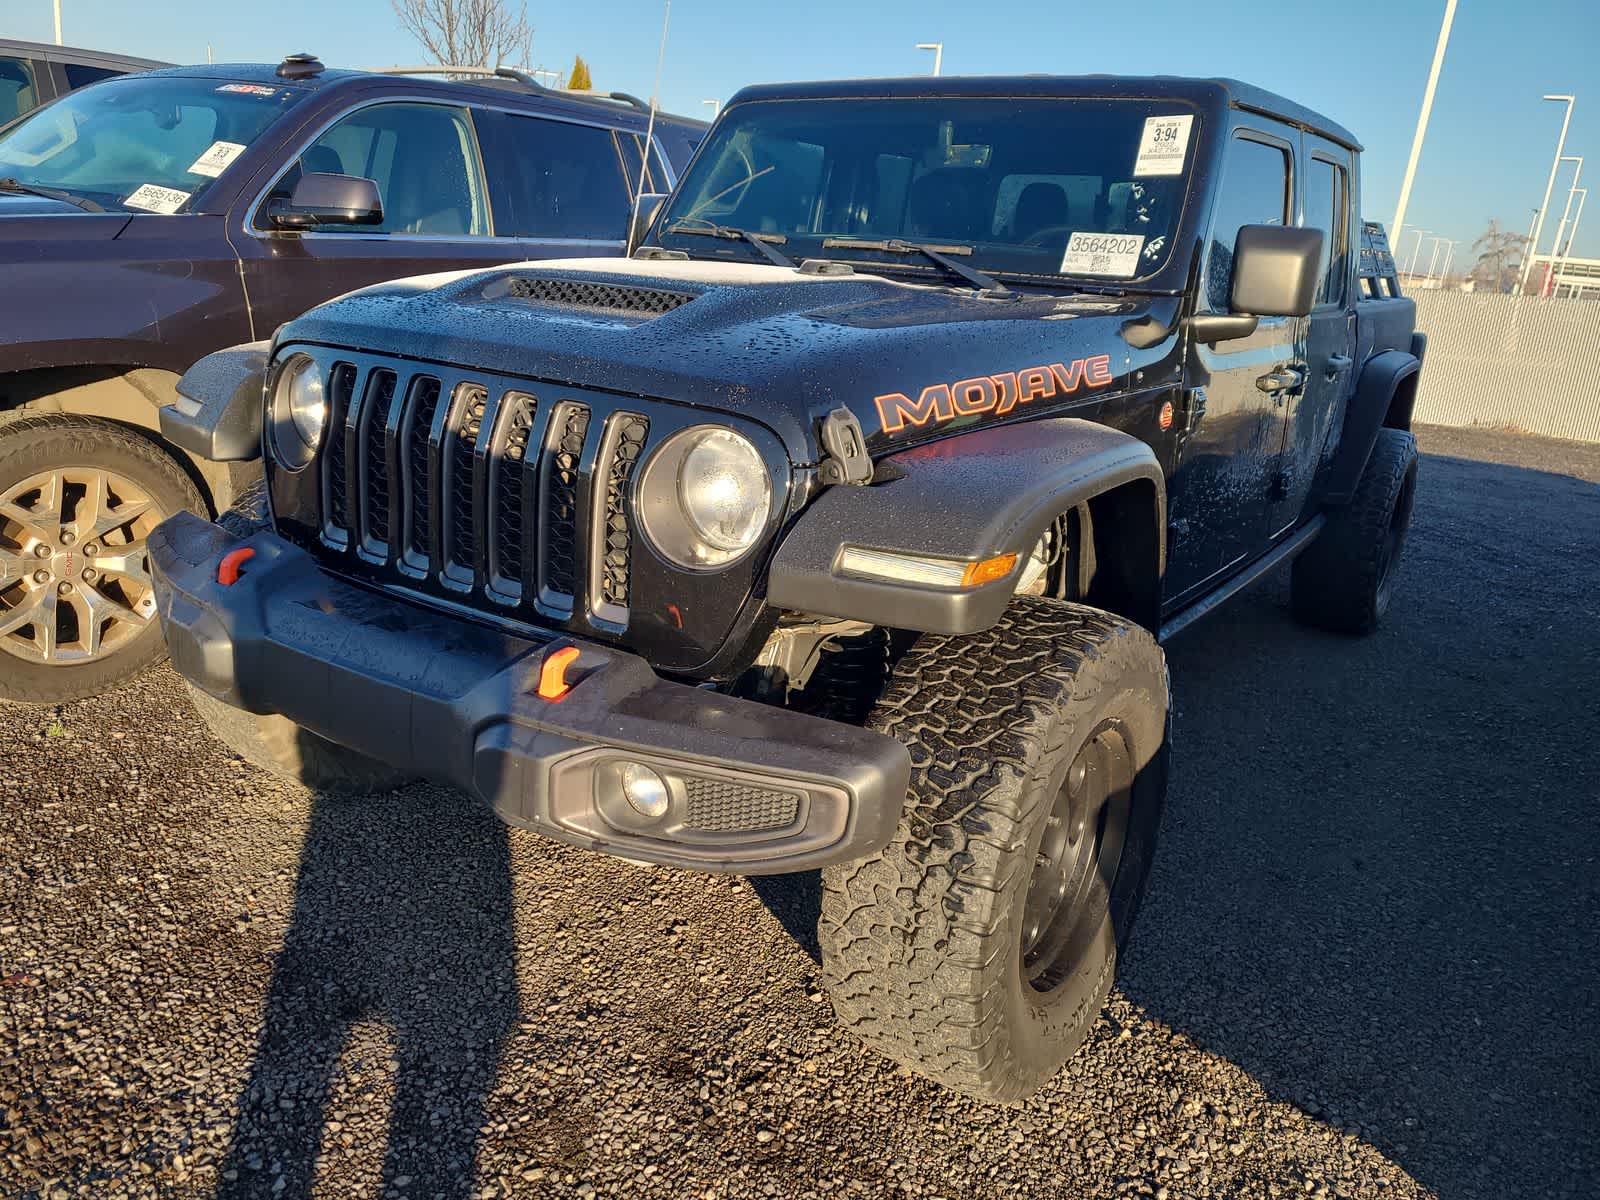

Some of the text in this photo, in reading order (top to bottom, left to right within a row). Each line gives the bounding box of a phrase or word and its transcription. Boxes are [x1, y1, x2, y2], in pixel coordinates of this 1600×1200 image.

[1153, 127, 1178, 142] 3:94
[1071, 236, 1137, 255] 3564202
[873, 353, 1113, 433] MOJAVE
[64, 551, 73, 577] GMC
